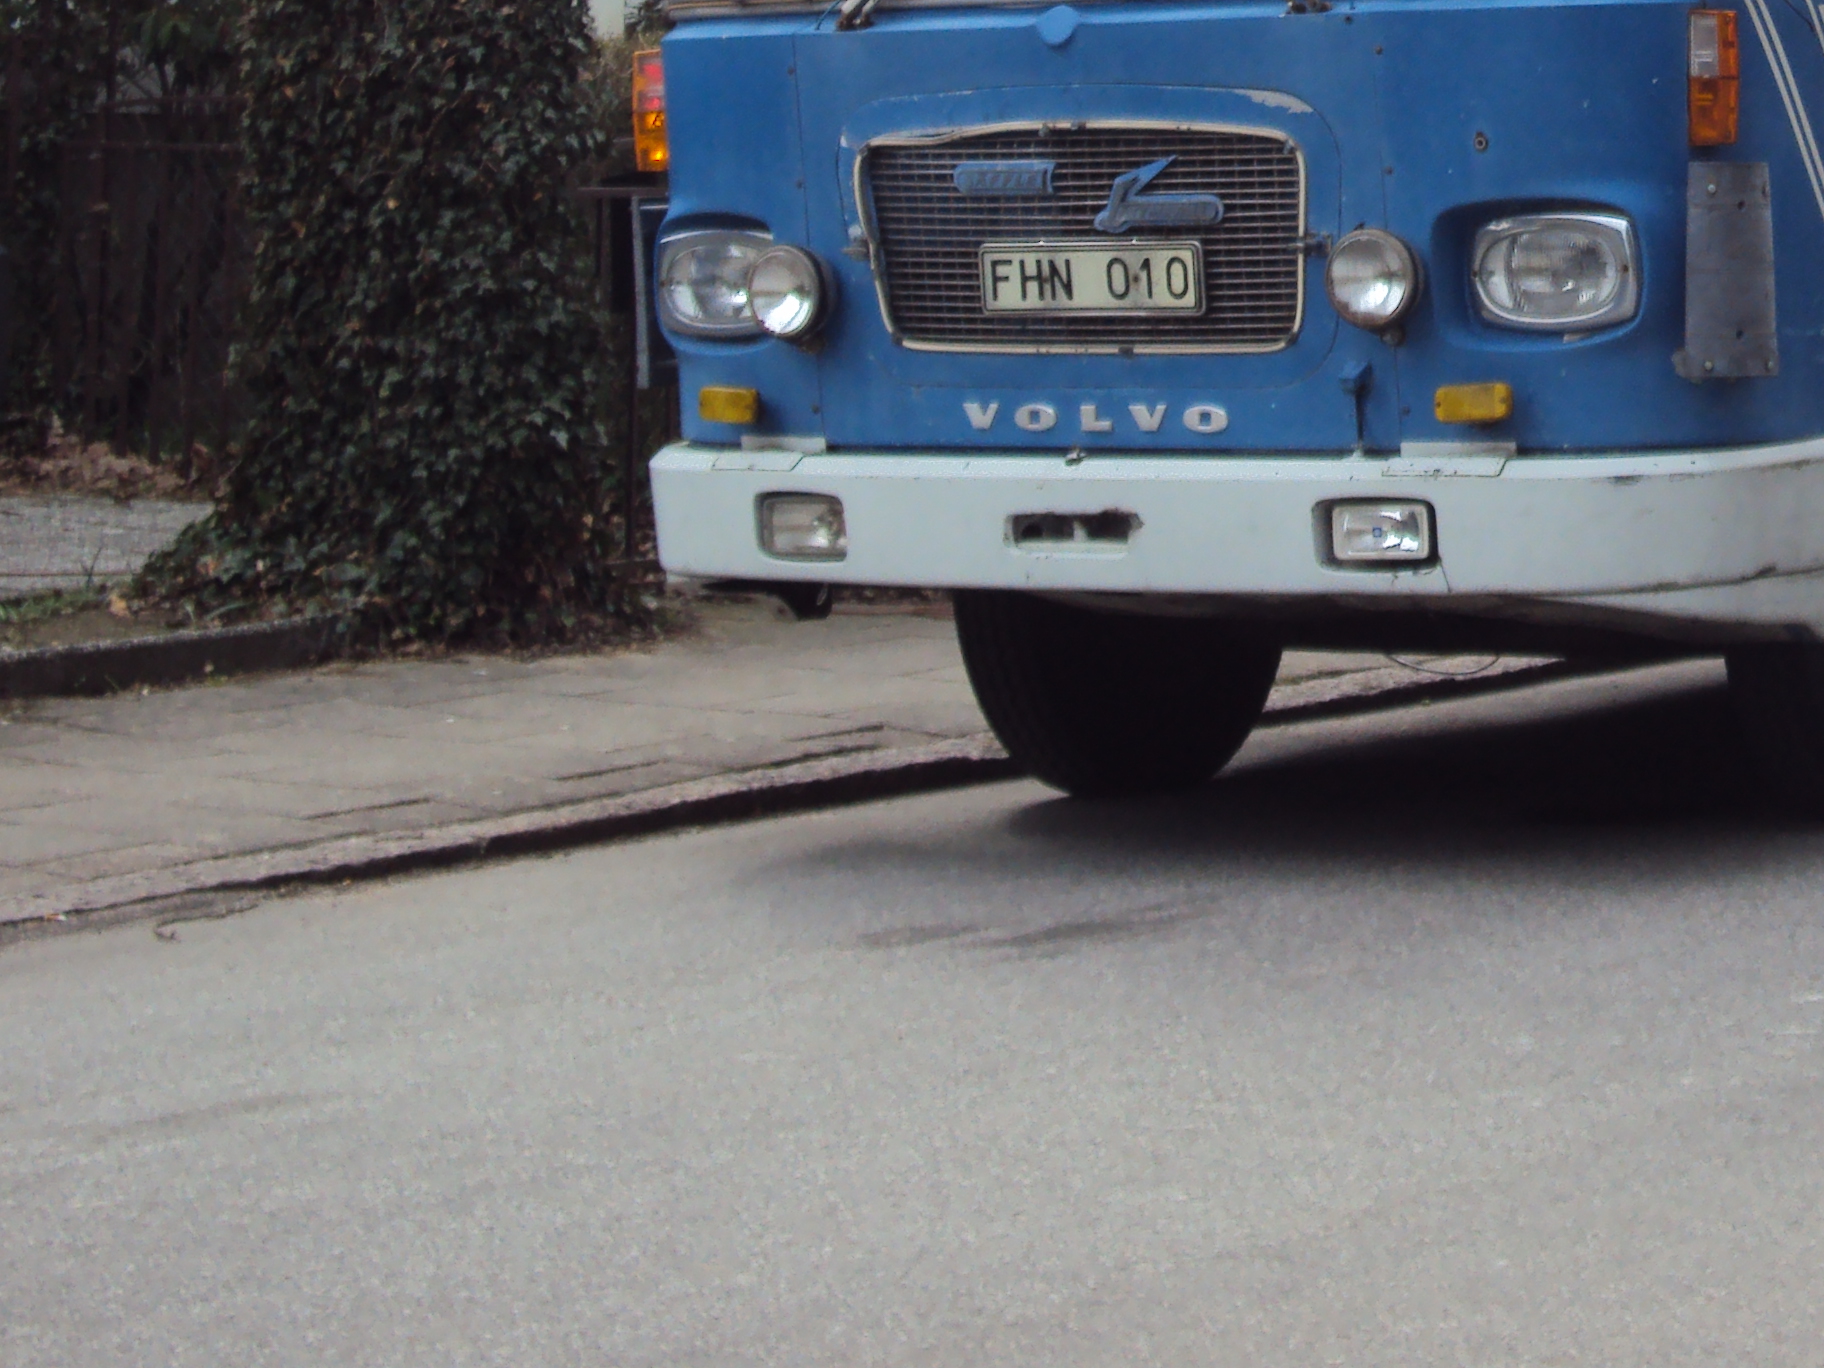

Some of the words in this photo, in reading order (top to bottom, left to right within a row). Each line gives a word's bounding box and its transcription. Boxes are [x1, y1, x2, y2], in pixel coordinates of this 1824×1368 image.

[990, 258, 1074, 302] FHN
[1106, 256, 1189, 301] 010
[962, 401, 1230, 434] VOLVO
